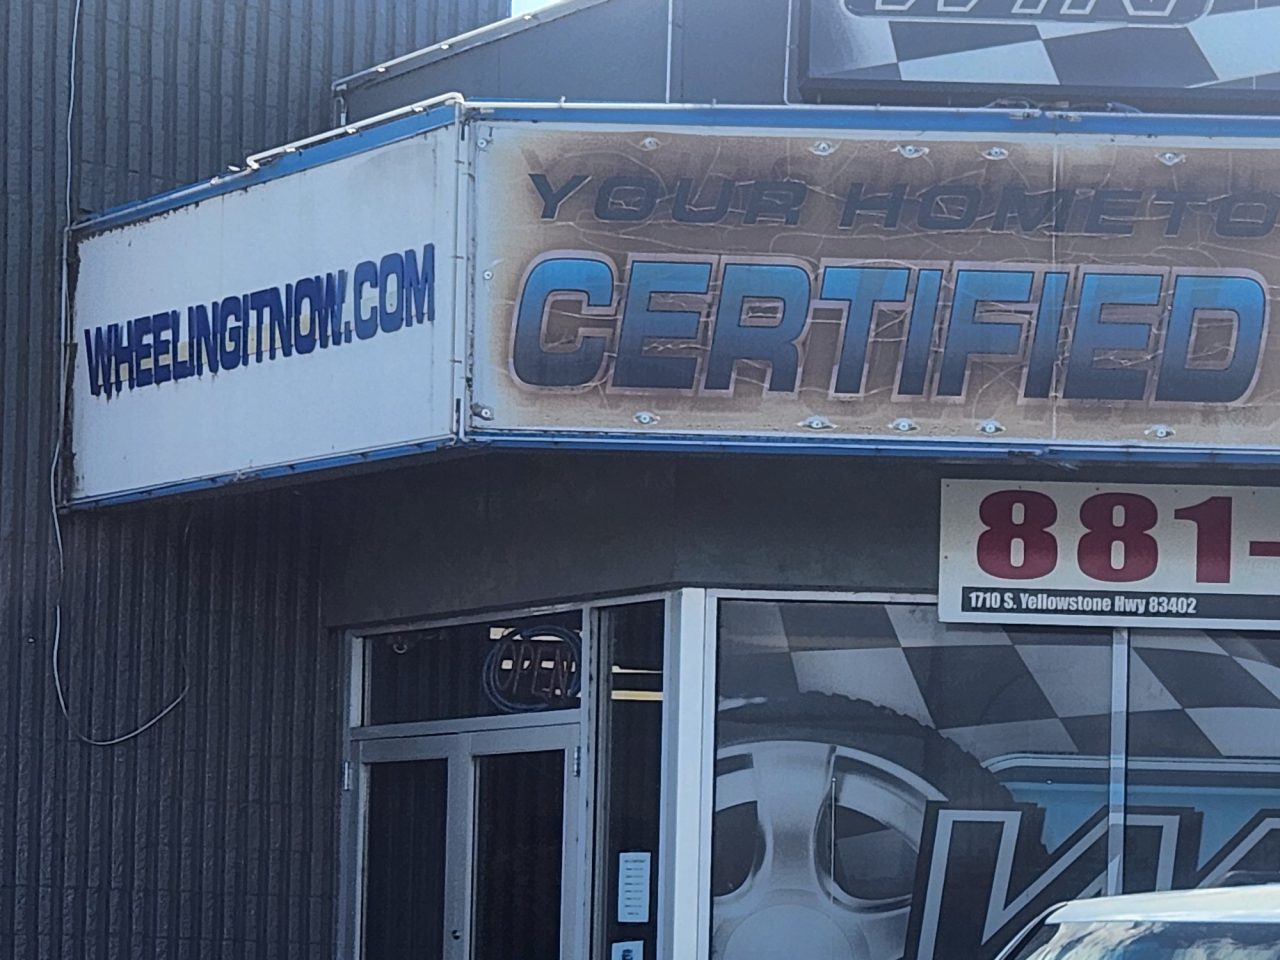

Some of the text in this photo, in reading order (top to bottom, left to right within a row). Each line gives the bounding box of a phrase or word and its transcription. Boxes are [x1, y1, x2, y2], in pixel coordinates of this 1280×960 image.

[527, 173, 809, 228] YOUR
[84, 242, 435, 399] WHEELINGITNOW.COM
[510, 252, 1268, 405] CERTIFIED
[968, 591, 1197, 614] 1710 S. Yellowstone Hwy 83402
[495, 639, 574, 699] OPEN
